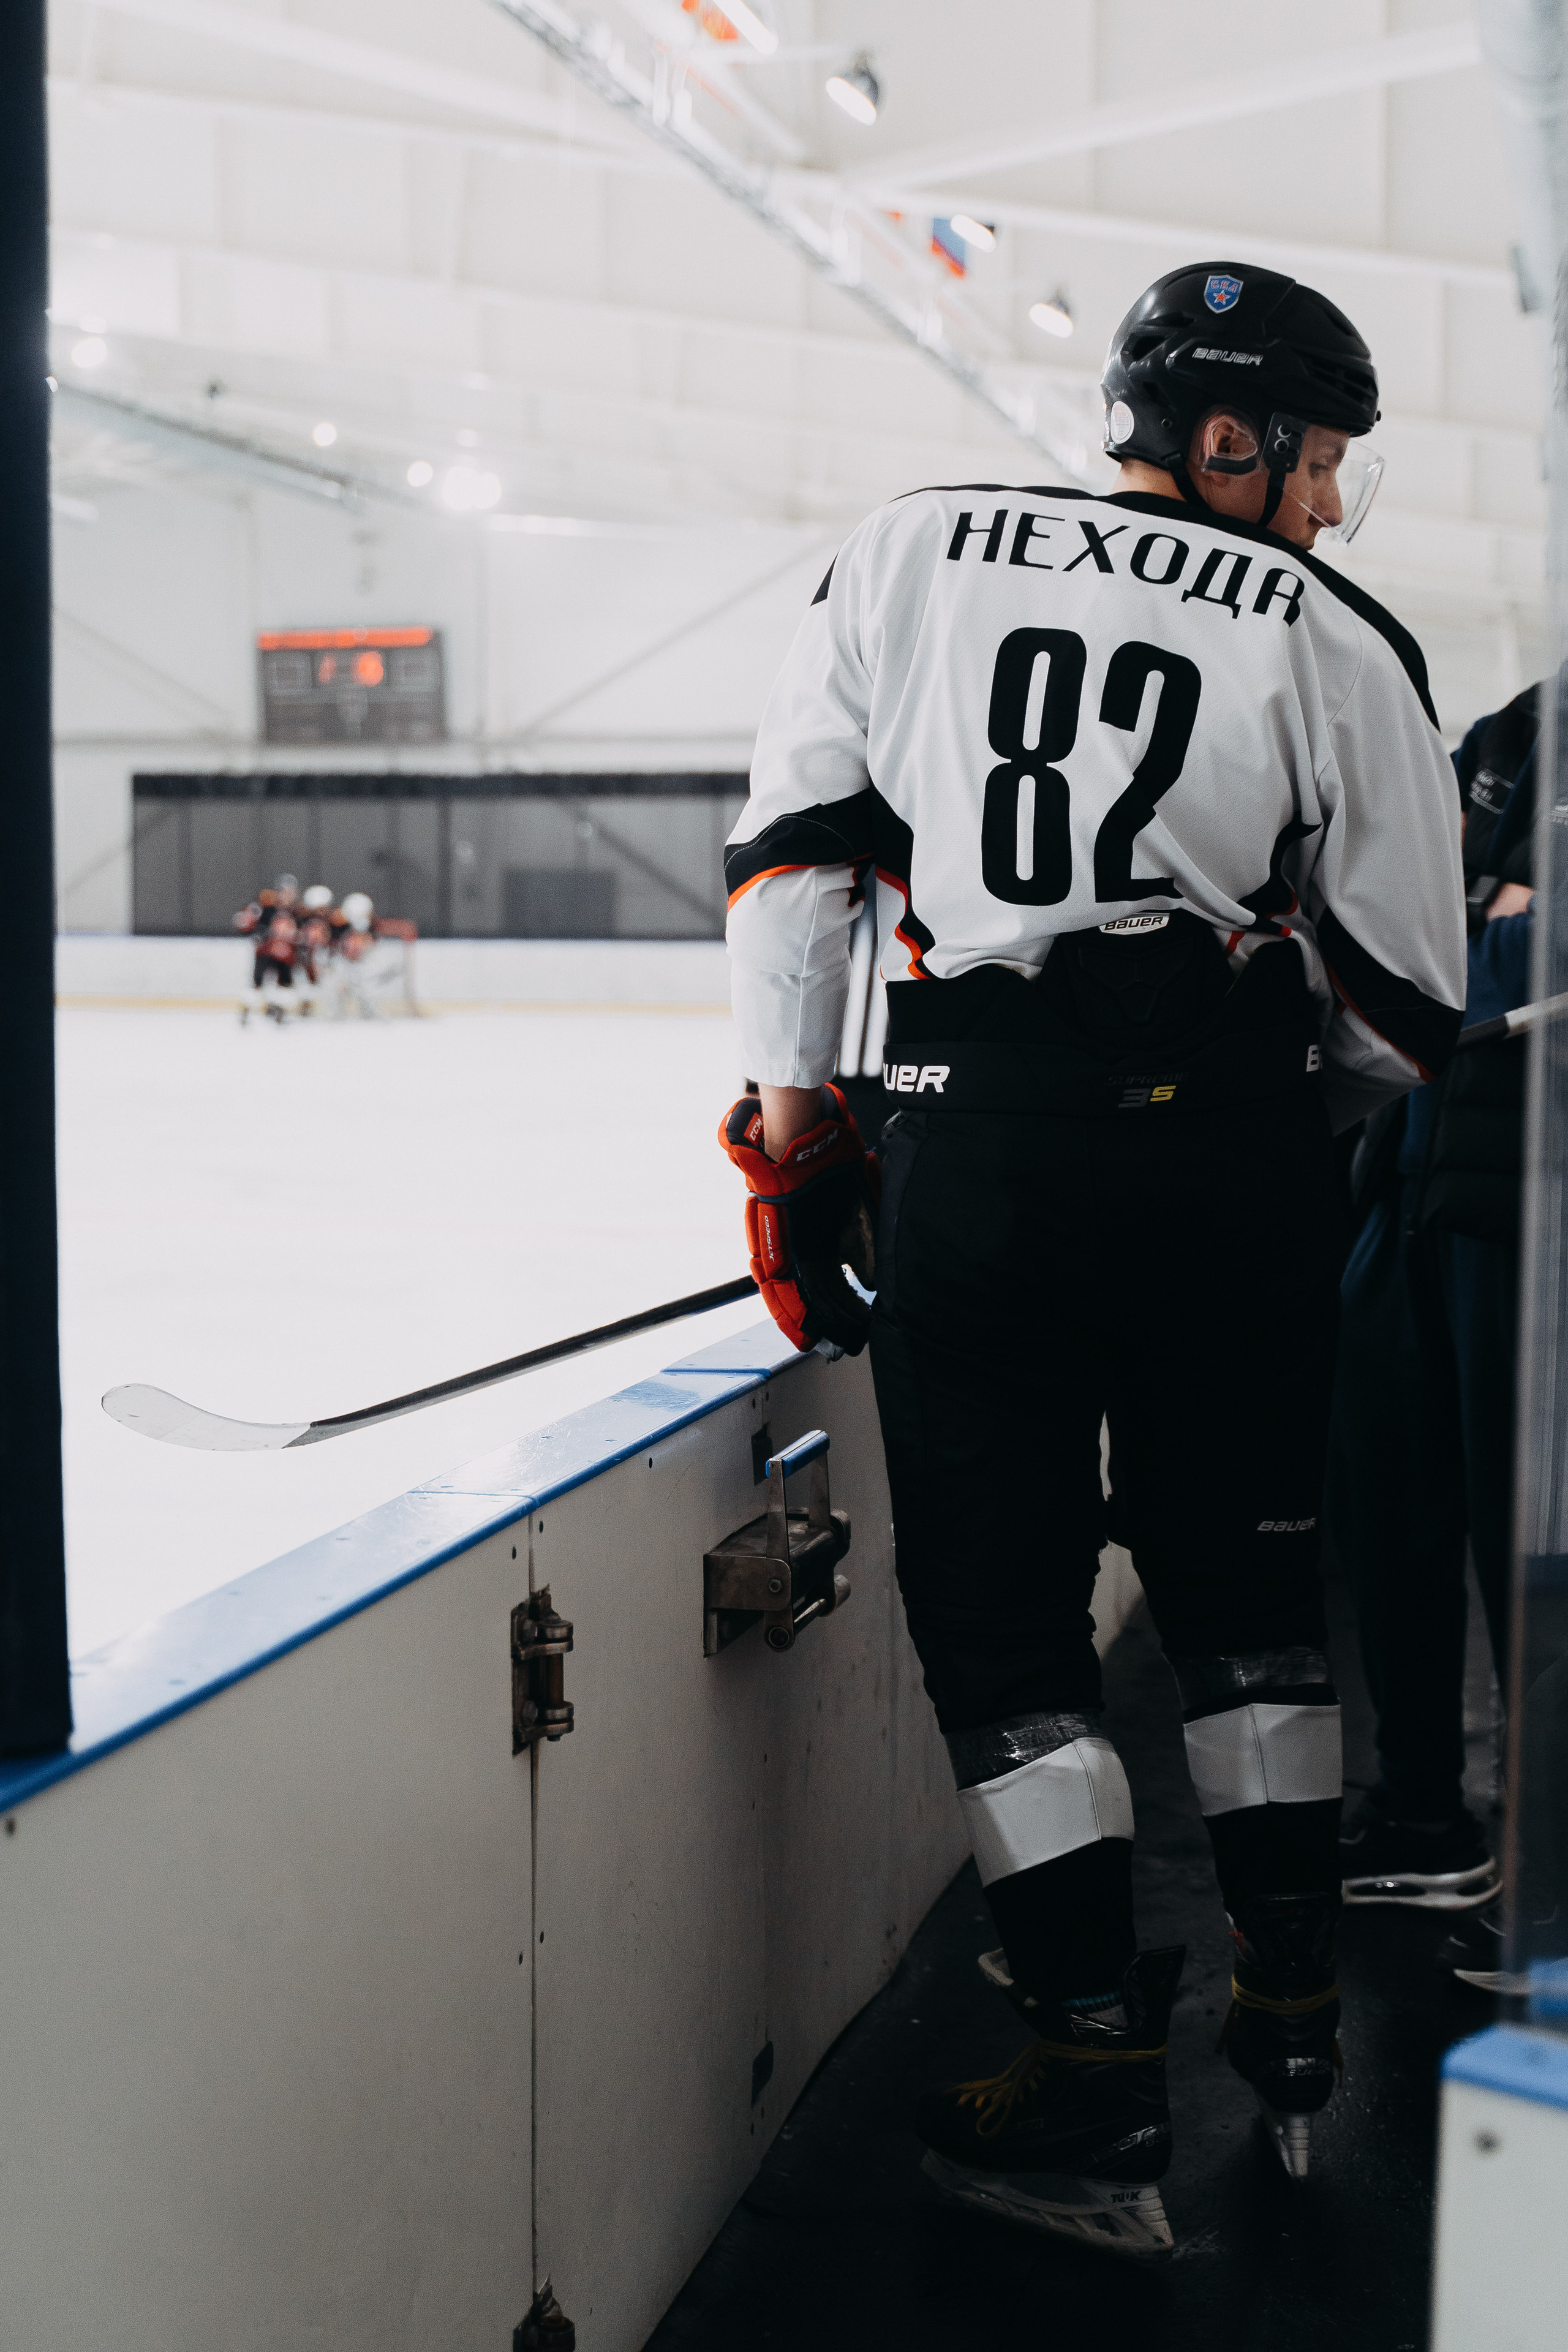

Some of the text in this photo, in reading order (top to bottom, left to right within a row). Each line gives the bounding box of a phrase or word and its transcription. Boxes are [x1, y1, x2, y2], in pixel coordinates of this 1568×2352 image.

[1192, 347, 1264, 366] BAUER
[946, 509, 1305, 627] НЕХОДА
[981, 627, 1202, 907] 82
[1104, 917, 1163, 930] BAUER
[883, 1063, 951, 1093] UER
[1118, 1085, 1177, 1108] 3S
[750, 1118, 763, 1141] CCM
[796, 1128, 838, 1161] CCM
